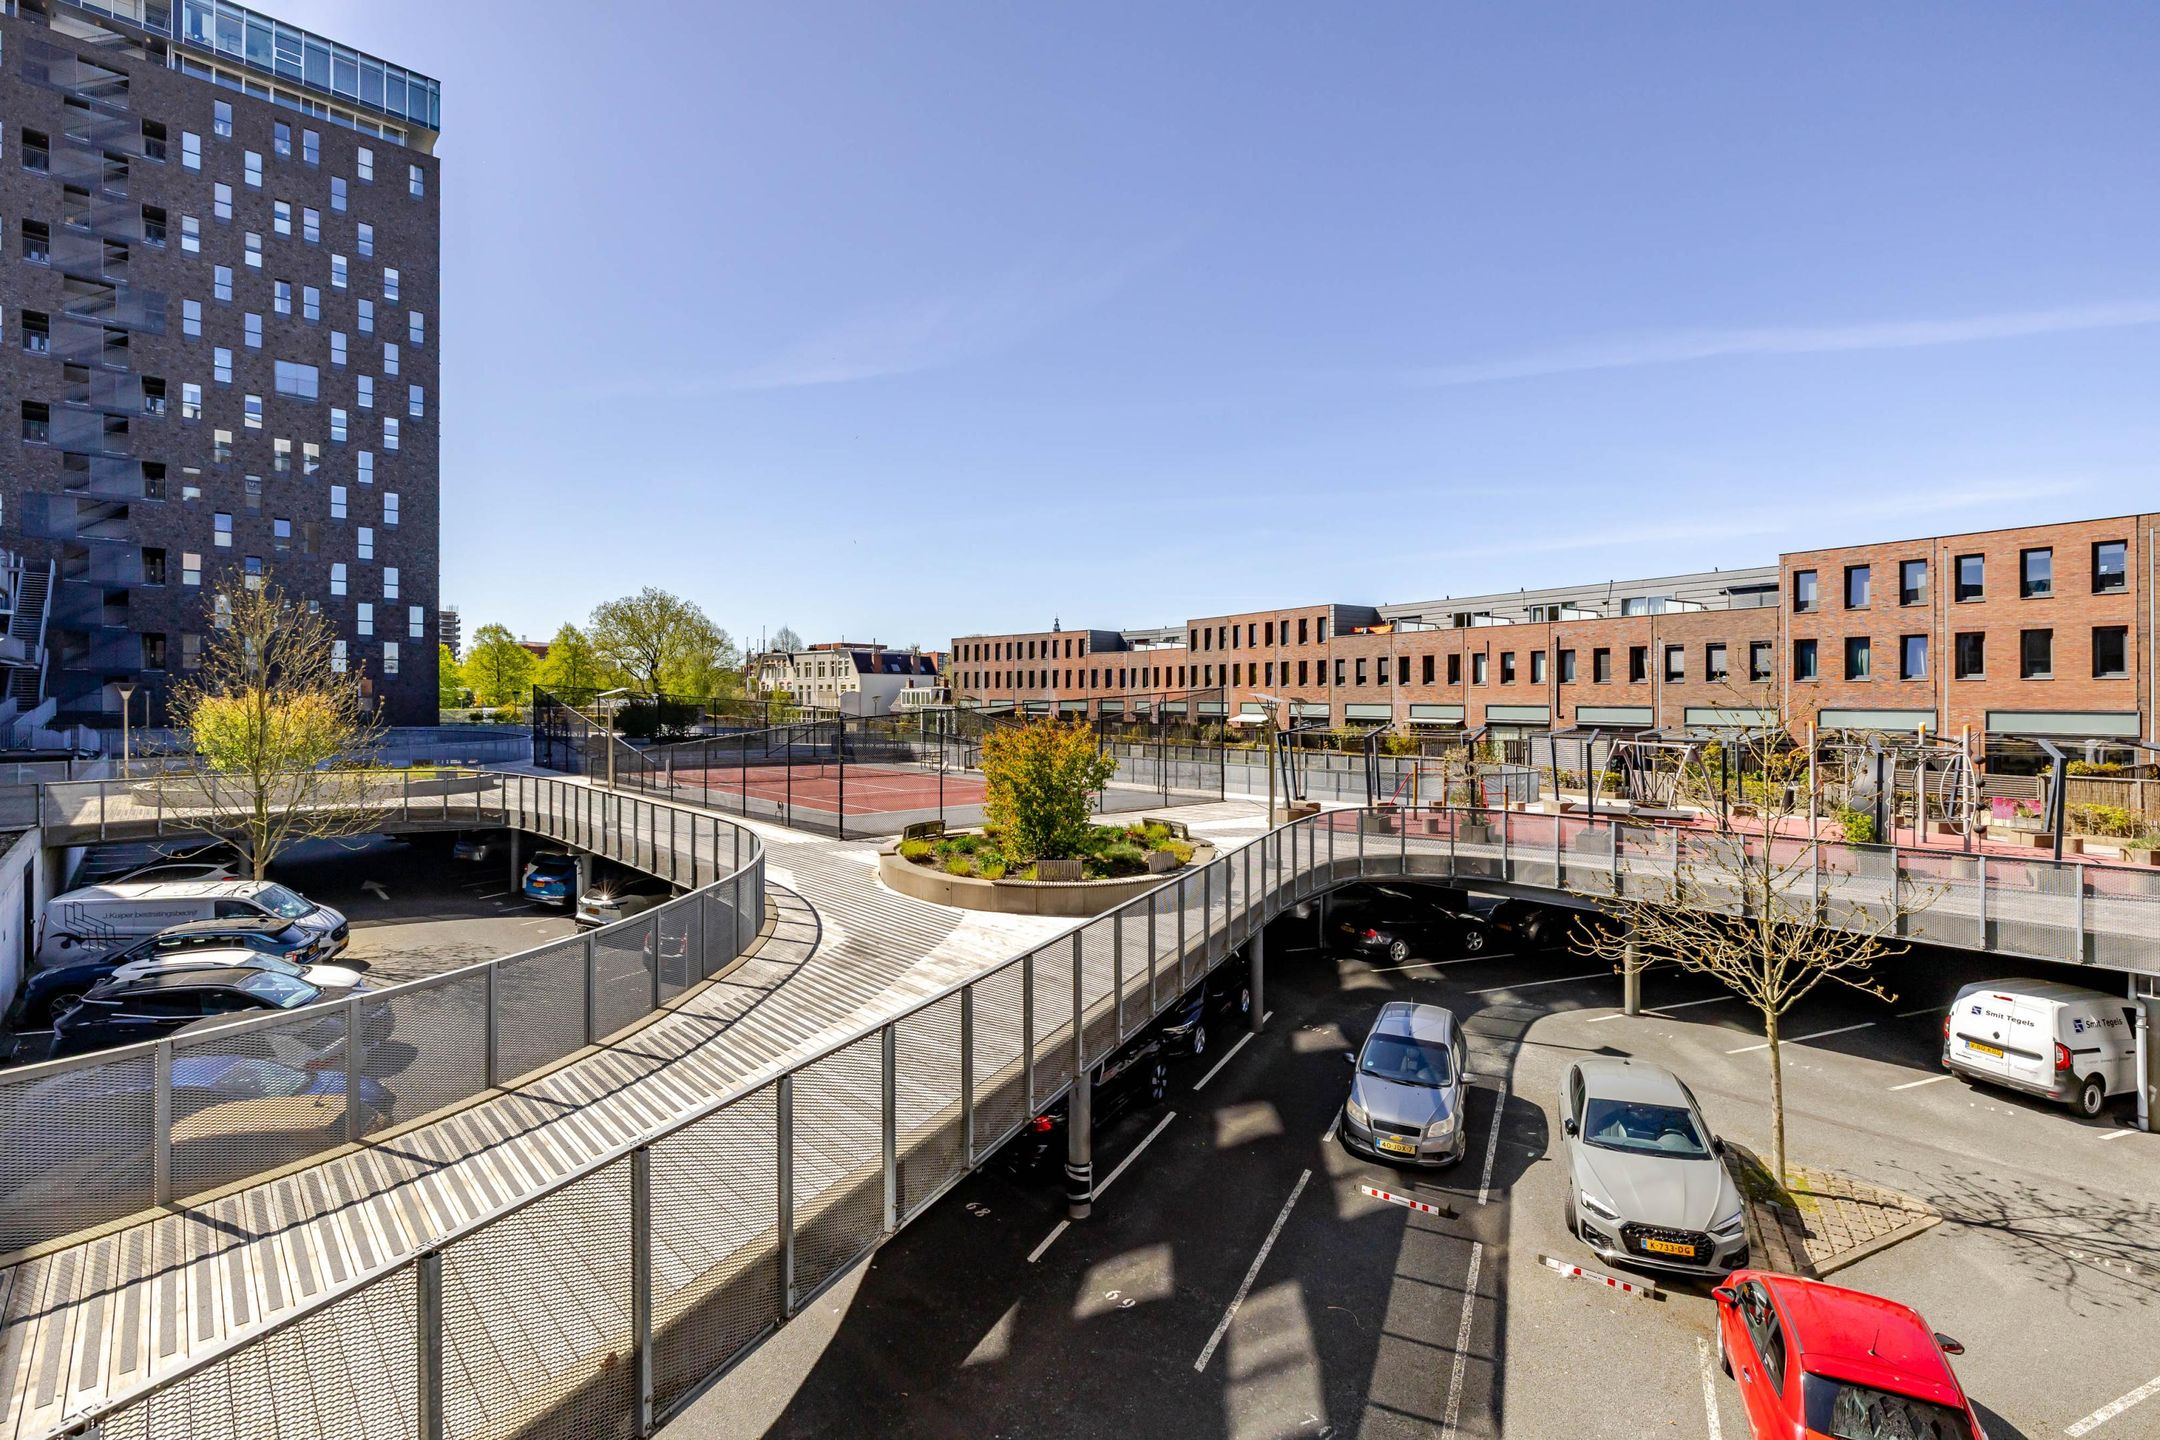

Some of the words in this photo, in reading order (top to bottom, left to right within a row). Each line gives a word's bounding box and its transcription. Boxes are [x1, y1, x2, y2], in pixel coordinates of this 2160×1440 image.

[1985, 1010, 2004, 1020] Smit
[2006, 1015, 2035, 1028] Tegels
[2085, 1019, 2101, 1029] Smit
[2101, 1017, 2123, 1029] Tegels
[965, 1202, 991, 1217] 68
[1650, 1241, 1691, 1255] K-733-DG
